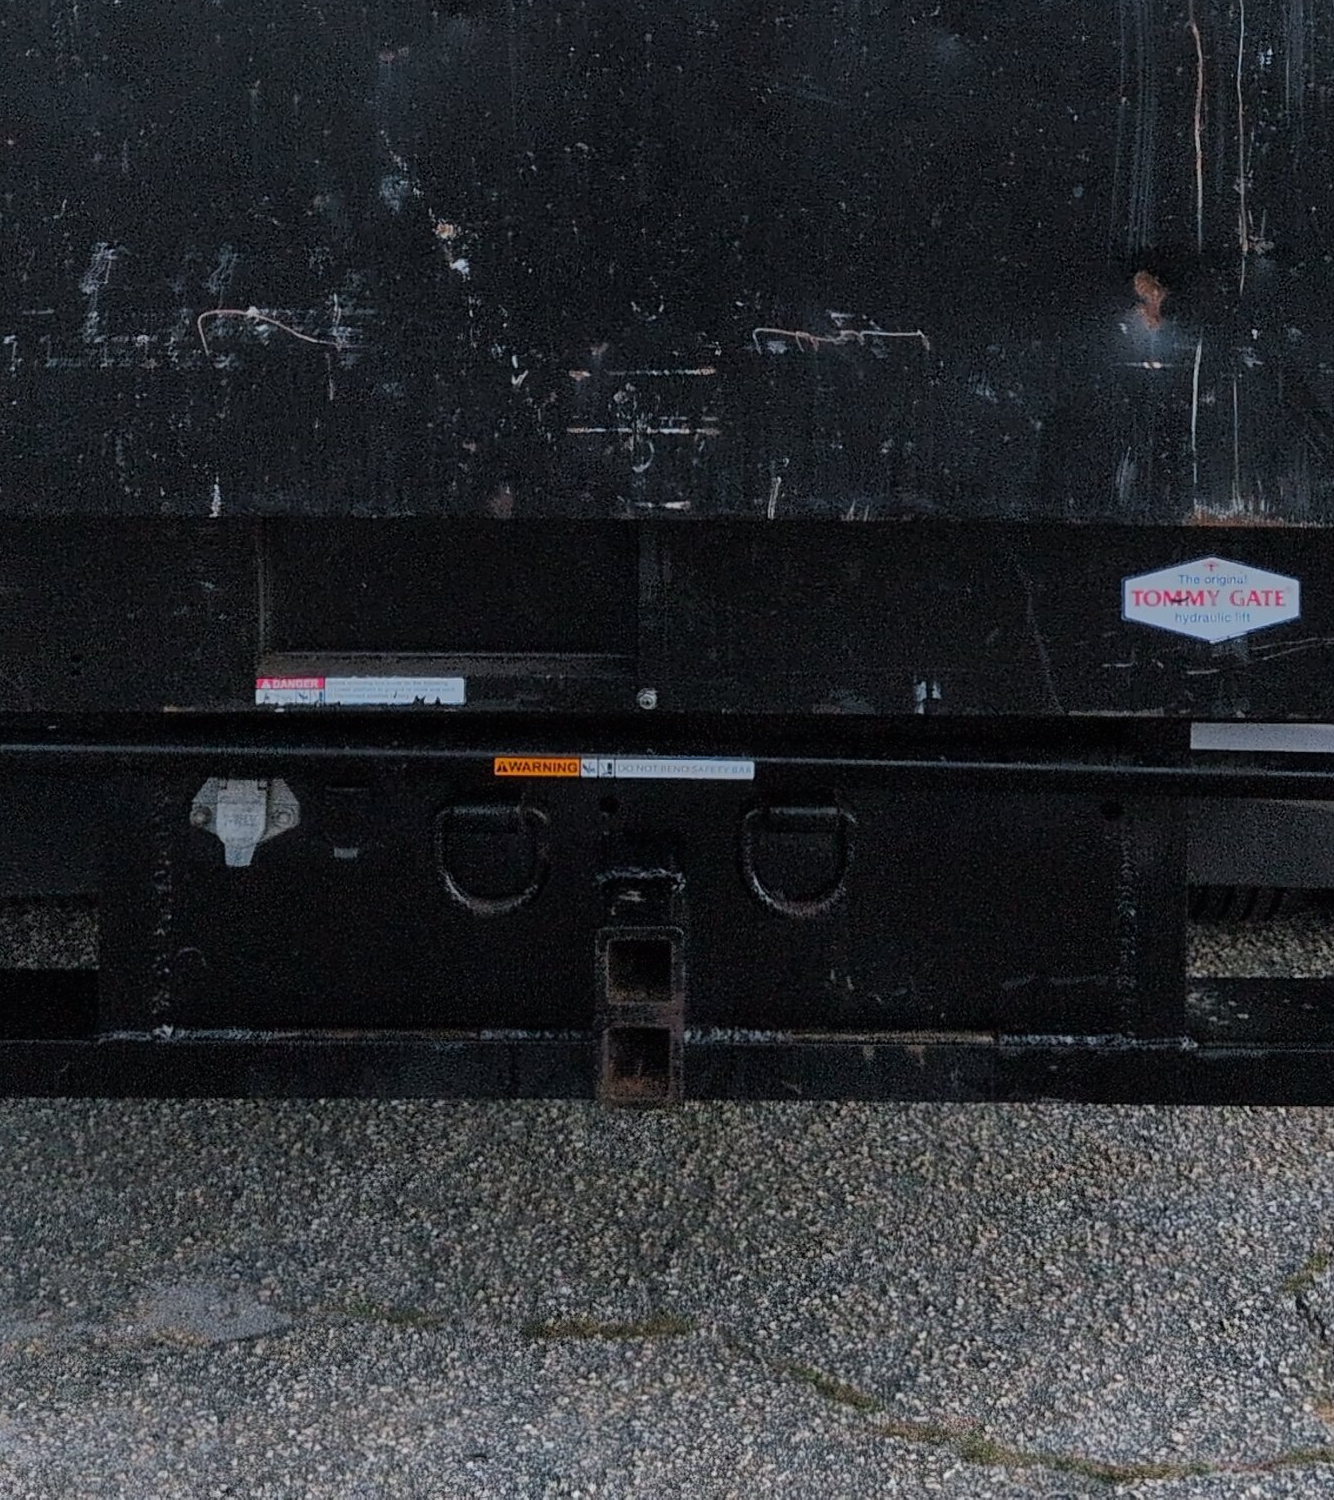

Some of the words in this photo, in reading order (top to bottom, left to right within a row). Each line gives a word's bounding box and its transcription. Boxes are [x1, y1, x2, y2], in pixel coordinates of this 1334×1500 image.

[1179, 574, 1200, 585] The
[1204, 574, 1248, 587] original
[1131, 589, 1220, 608] TOMMY
[1229, 590, 1287, 608] GATE
[1175, 612, 1232, 626] hydraulic
[1234, 612, 1251, 623] lift
[273, 678, 318, 690] DANGER
[508, 761, 579, 774] WARNING
[617, 764, 634, 774] DO
[635, 764, 658, 774] NOT
[660, 764, 690, 774] BEND
[691, 764, 729, 775] SAFETY
